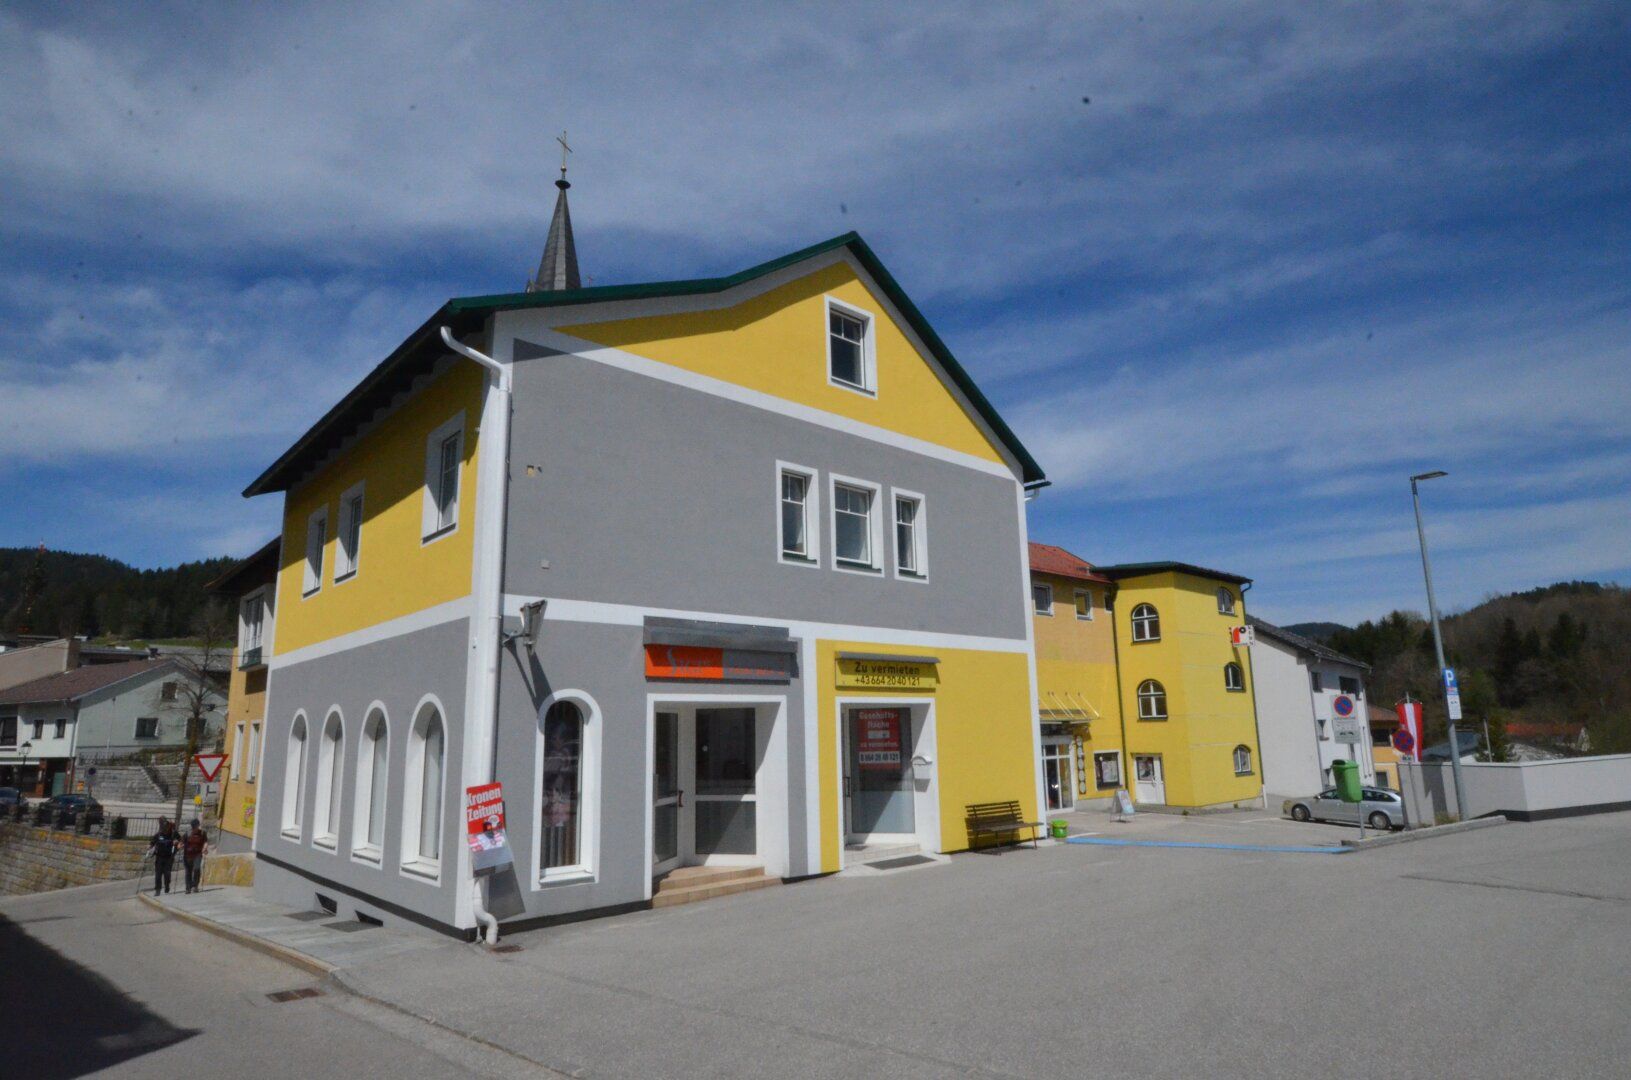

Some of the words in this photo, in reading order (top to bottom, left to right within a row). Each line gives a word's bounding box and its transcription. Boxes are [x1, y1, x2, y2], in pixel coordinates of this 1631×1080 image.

[855, 661, 868, 673] Zu
[871, 665, 920, 675] vermieten
[1445, 669, 1454, 686] P
[467, 788, 501, 806] Kronen
[467, 802, 503, 821] Zeitung
